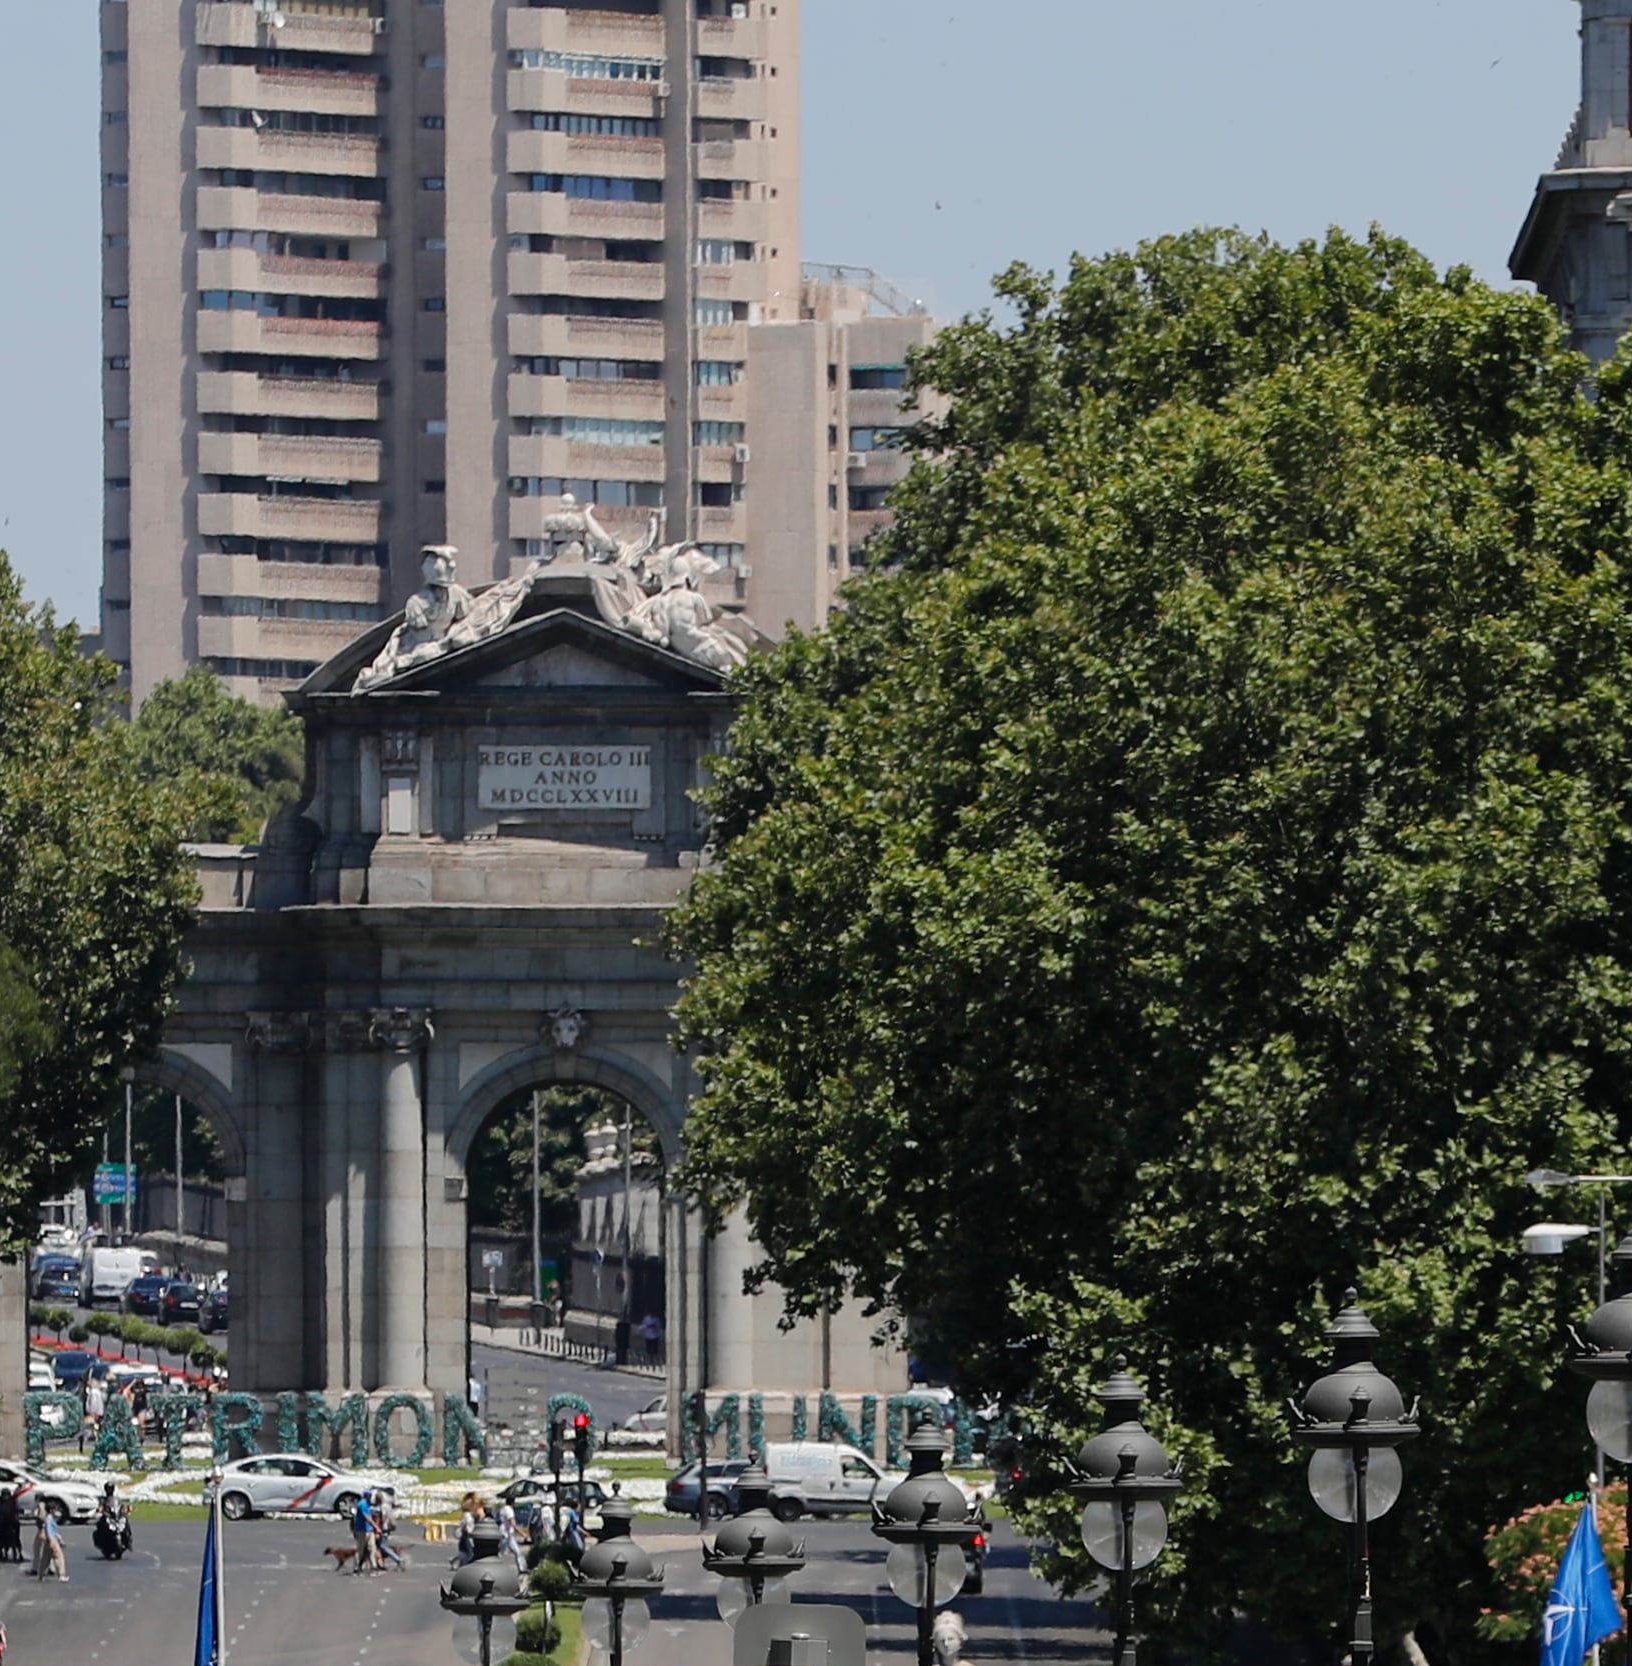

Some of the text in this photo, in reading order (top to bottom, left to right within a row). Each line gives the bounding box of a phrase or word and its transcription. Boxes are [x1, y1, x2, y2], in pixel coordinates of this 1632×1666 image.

[480, 752, 650, 766] REGE CAROLO III
[535, 771, 597, 785] ANNO
[491, 789, 639, 804] MDCCLXXVIII
[24, 1391, 598, 1470] PATRIMONO
